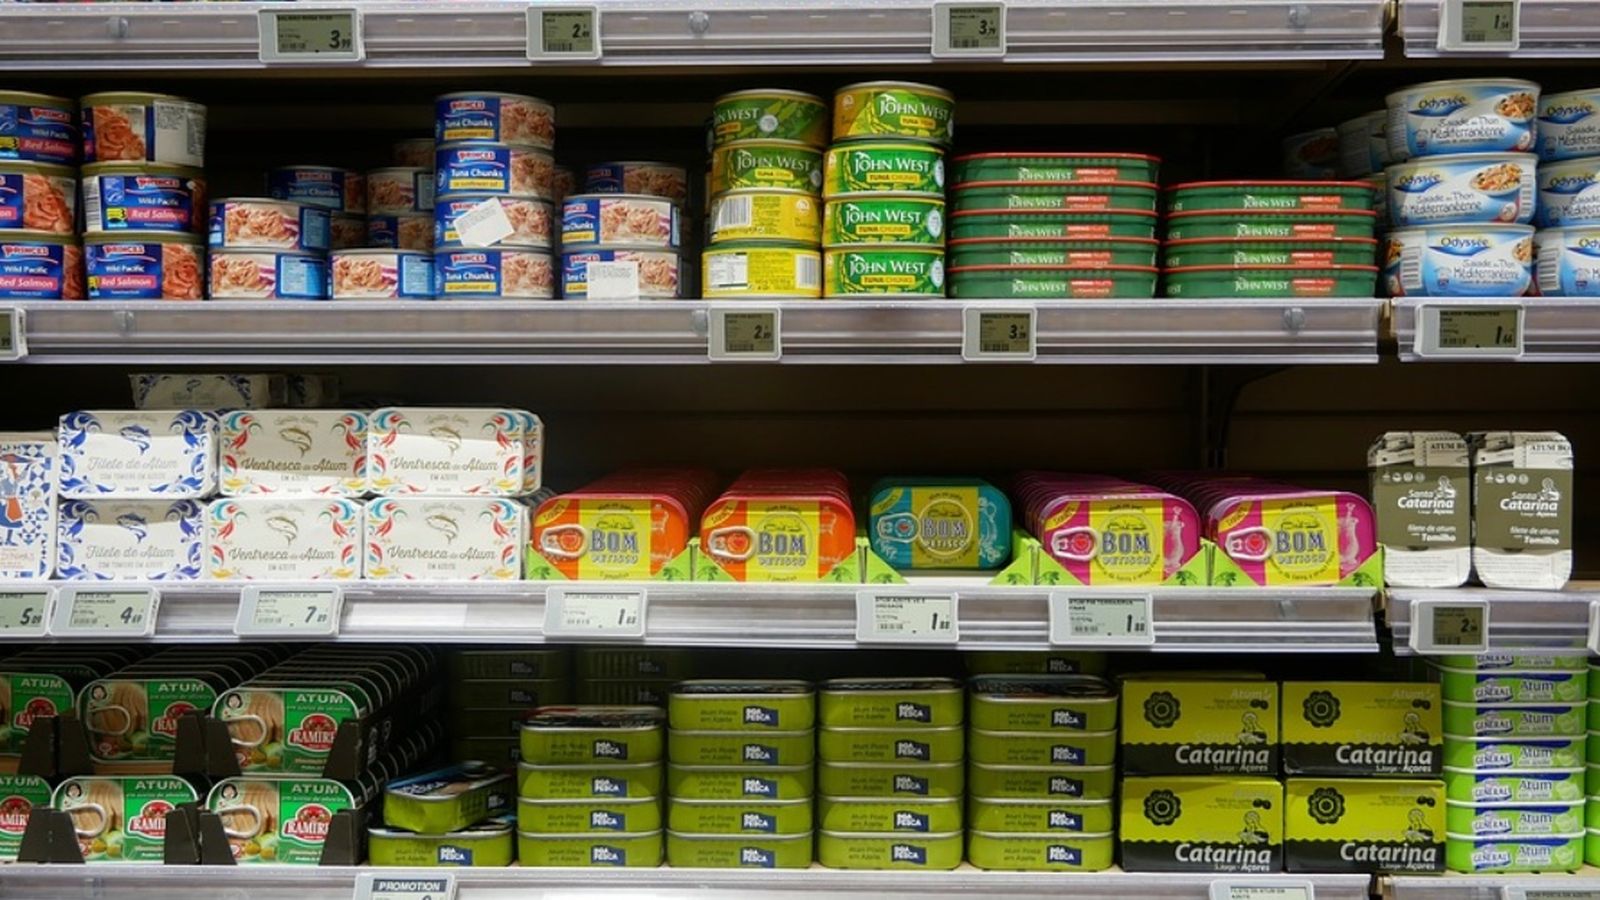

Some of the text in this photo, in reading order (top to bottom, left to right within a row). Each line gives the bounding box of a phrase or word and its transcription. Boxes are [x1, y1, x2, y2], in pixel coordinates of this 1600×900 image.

[1419, 96, 1466, 109] Odyssée
[726, 108, 759, 120] WEST
[879, 98, 947, 120] JOHN WEST
[446, 118, 493, 127] Tuna Chunks
[459, 152, 496, 161] PRINCES
[736, 155, 811, 171] JOHN WEST
[855, 158, 929, 174] JOHN WEST
[452, 168, 503, 177] Tuna Chunks
[1046, 170, 1072, 180] WEST
[138, 197, 179, 206] Wild Pacific
[1036, 198, 1061, 207] WEST
[1270, 199, 1296, 207] WEST
[132, 209, 184, 220] Red Salmon
[846, 209, 921, 225] JOHN WEST
[1037, 227, 1061, 236] WEST
[1264, 227, 1289, 236] WEST
[1441, 235, 1489, 247] Odyssée
[5, 246, 49, 256] PRINCES
[104, 246, 144, 255] PRINCES
[1039, 254, 1064, 263] WEST
[1261, 255, 1287, 263] WEST
[4, 265, 48, 275] Wild Pacific
[105, 265, 145, 274] Wild Pacific
[850, 260, 925, 276] JOHN WEST
[446, 271, 495, 281] Tuna Chunks
[101, 278, 152, 288] Red Salmon
[1040, 281, 1066, 292] WEST
[1262, 281, 1288, 290] WEST
[89, 457, 178, 471] Filete de Atum
[241, 459, 301, 472] Ventresca
[317, 458, 347, 471] Atum
[390, 457, 451, 471] Ventresca
[463, 457, 498, 471] Atum
[1409, 490, 1433, 498] Santa
[1512, 491, 1536, 499] Santa
[1397, 497, 1455, 508] Catarina
[1500, 499, 1558, 510] Catarina
[922, 519, 966, 538] BOM
[592, 530, 638, 552] BOM
[1276, 531, 1326, 552] BOM
[1422, 533, 1456, 541] Tomilho
[1524, 536, 1559, 544] Tomilho
[759, 532, 807, 555] BOM
[1102, 532, 1150, 554] BOM
[86, 545, 174, 558] Filete de Atum
[229, 547, 335, 560] Ventresca Atum
[386, 547, 496, 560] Ventresca Atum
[21, 679, 62, 691] ATUM
[158, 683, 206, 694] ATUM
[1476, 681, 1554, 697] GENERAL Atum
[295, 694, 343, 703] ATUM
[746, 714, 771, 722] PESCA
[1476, 714, 1554, 730] GENERAL Atum
[745, 752, 770, 760] PESCA
[1175, 745, 1269, 767] Catarina
[1335, 745, 1433, 767] Catarina
[1475, 747, 1553, 764] GENERAL Atum
[1240, 764, 1268, 774] Açores
[1403, 764, 1432, 775] Açores
[135, 781, 182, 790] ATUM
[291, 784, 339, 794] ATUM
[1475, 780, 1552, 797] GENERAL Atum
[1474, 813, 1552, 830] GENERAL Atum
[1175, 845, 1271, 866] Catarina
[1340, 843, 1436, 864] Catarina
[1474, 845, 1552, 863] GENERAL Atum
[1241, 864, 1269, 874] Açores
[1405, 863, 1434, 873] Açores
[379, 881, 440, 891] PROMOTION
